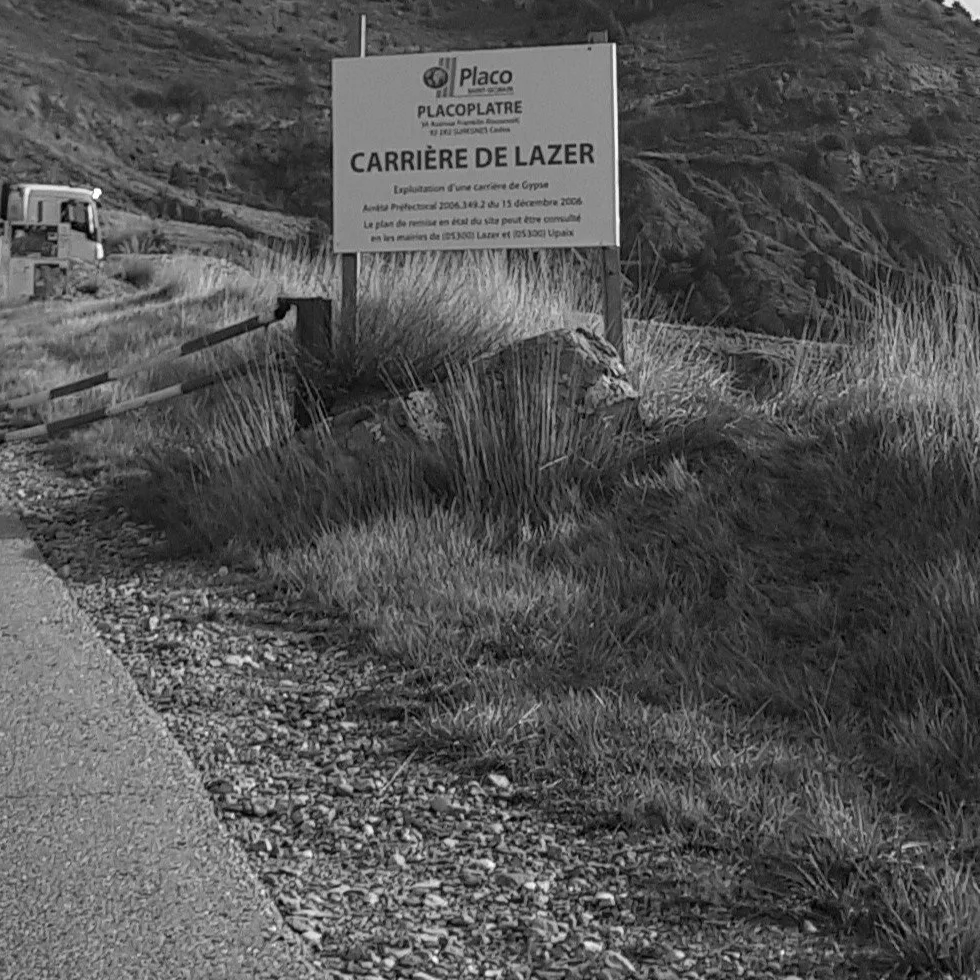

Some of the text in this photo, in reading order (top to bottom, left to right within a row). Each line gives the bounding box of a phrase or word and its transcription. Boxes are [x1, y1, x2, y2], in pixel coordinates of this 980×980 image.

[459, 66, 513, 87] Placo
[417, 100, 523, 118] PLACOPLATRE
[350, 143, 595, 173] CARRIÈRE DE LAZER
[393, 180, 549, 195] Exploitation d'une carrière de Gypse
[390, 202, 437, 211] Préfectoral
[487, 200, 500, 208] du
[502, 199, 512, 208] 15
[514, 198, 558, 208] décembre
[560, 197, 583, 206] 2006
[363, 213, 581, 230] Le plan de remise en état du site peut être consulté
[370, 234, 382, 242] en
[383, 233, 395, 242] les
[396, 232, 428, 242] mairies
[429, 231, 440, 240] de
[476, 230, 500, 240] Lazer
[501, 230, 511, 239] et
[547, 228, 575, 238] Upaix
